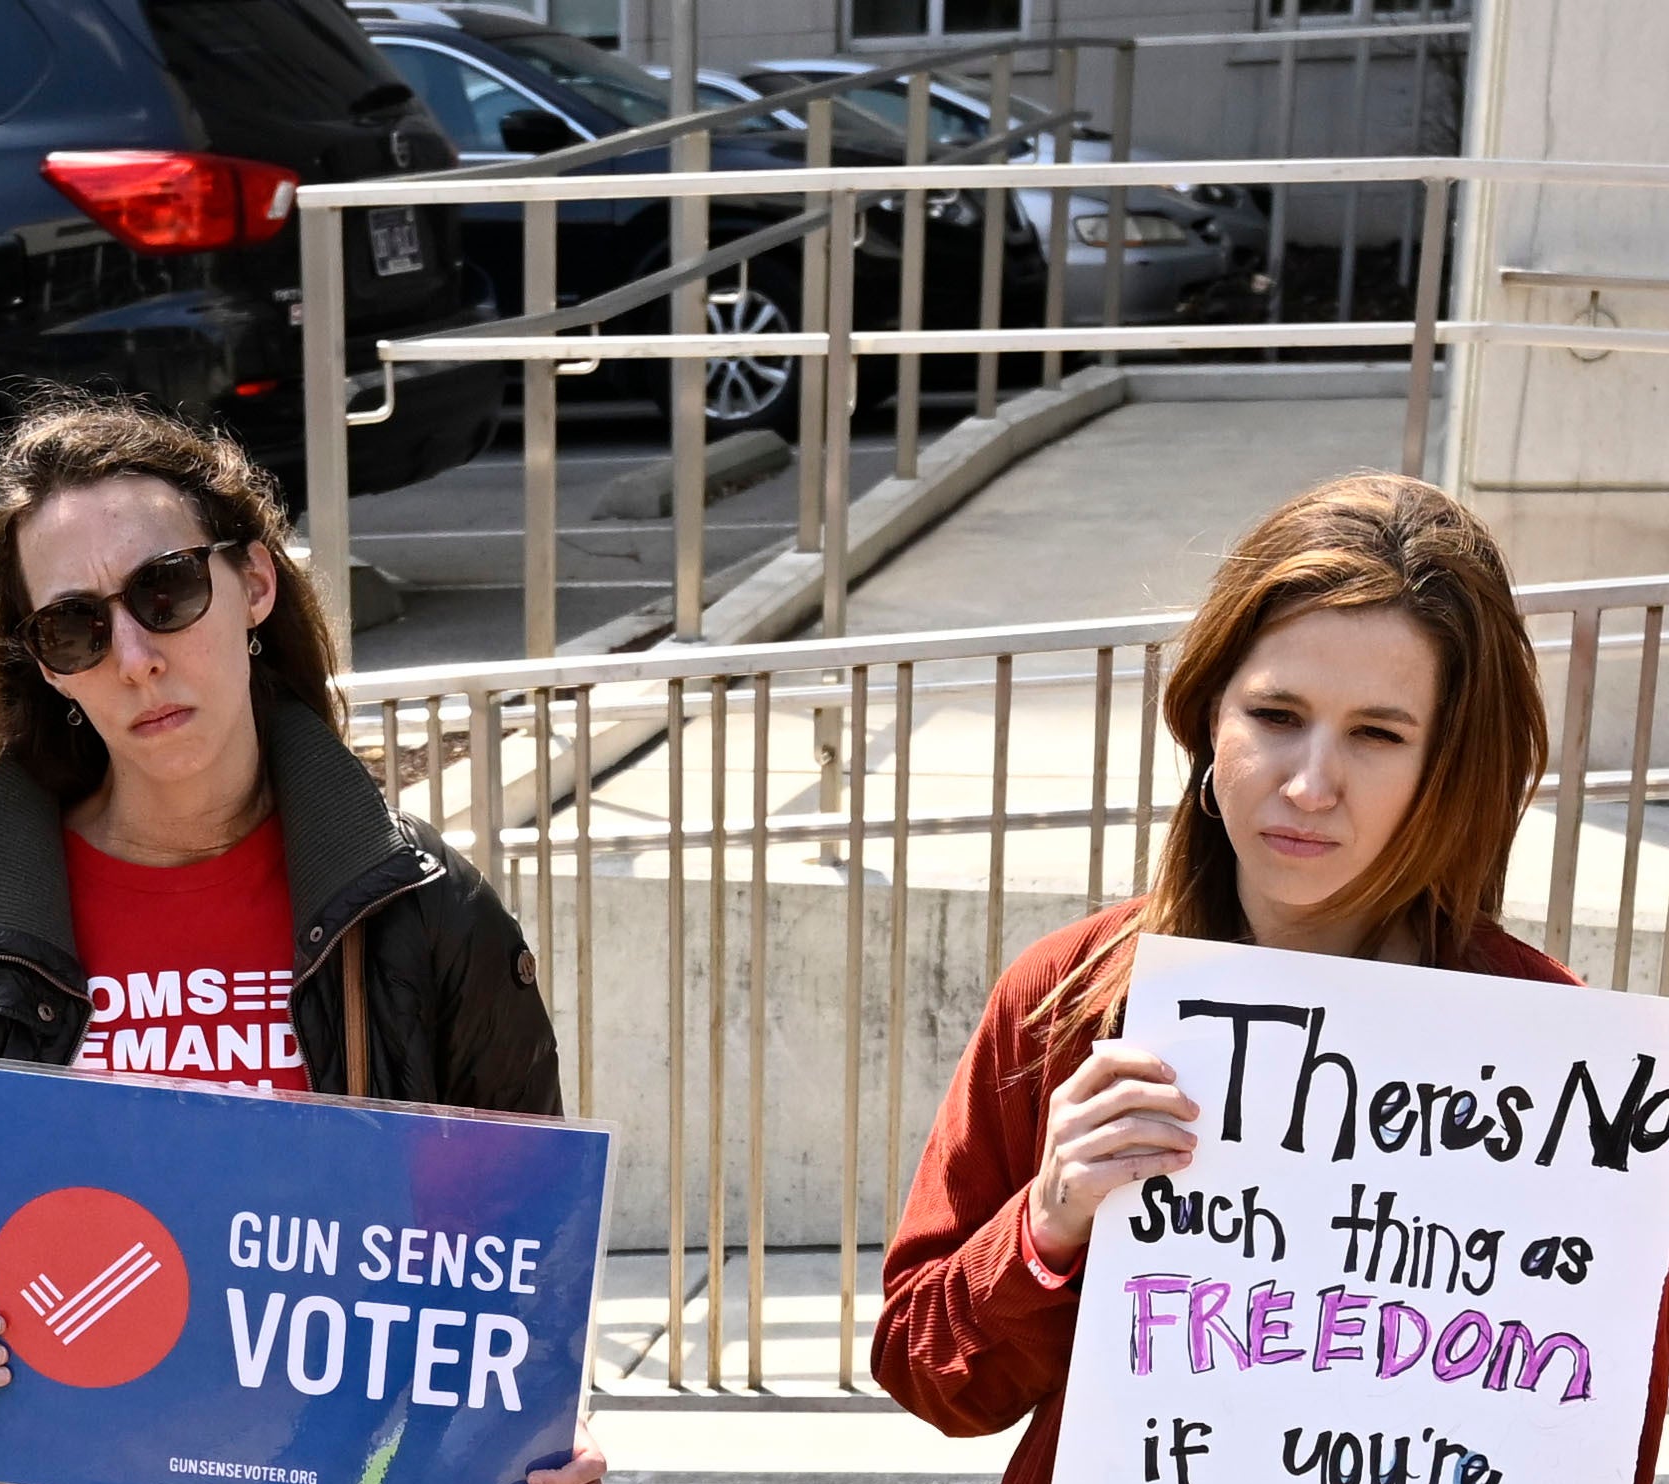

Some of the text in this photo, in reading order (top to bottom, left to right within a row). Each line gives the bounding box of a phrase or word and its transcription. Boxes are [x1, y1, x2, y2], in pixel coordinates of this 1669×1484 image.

[87, 968, 228, 1024] OMS
[68, 1022, 308, 1072] EMAND
[1177, 998, 1534, 1164] There's
[228, 1211, 542, 1296] GUN SENSE
[1330, 1183, 1506, 1296] thing
[1519, 1236, 1594, 1285] as
[226, 1287, 529, 1412] VOTER
